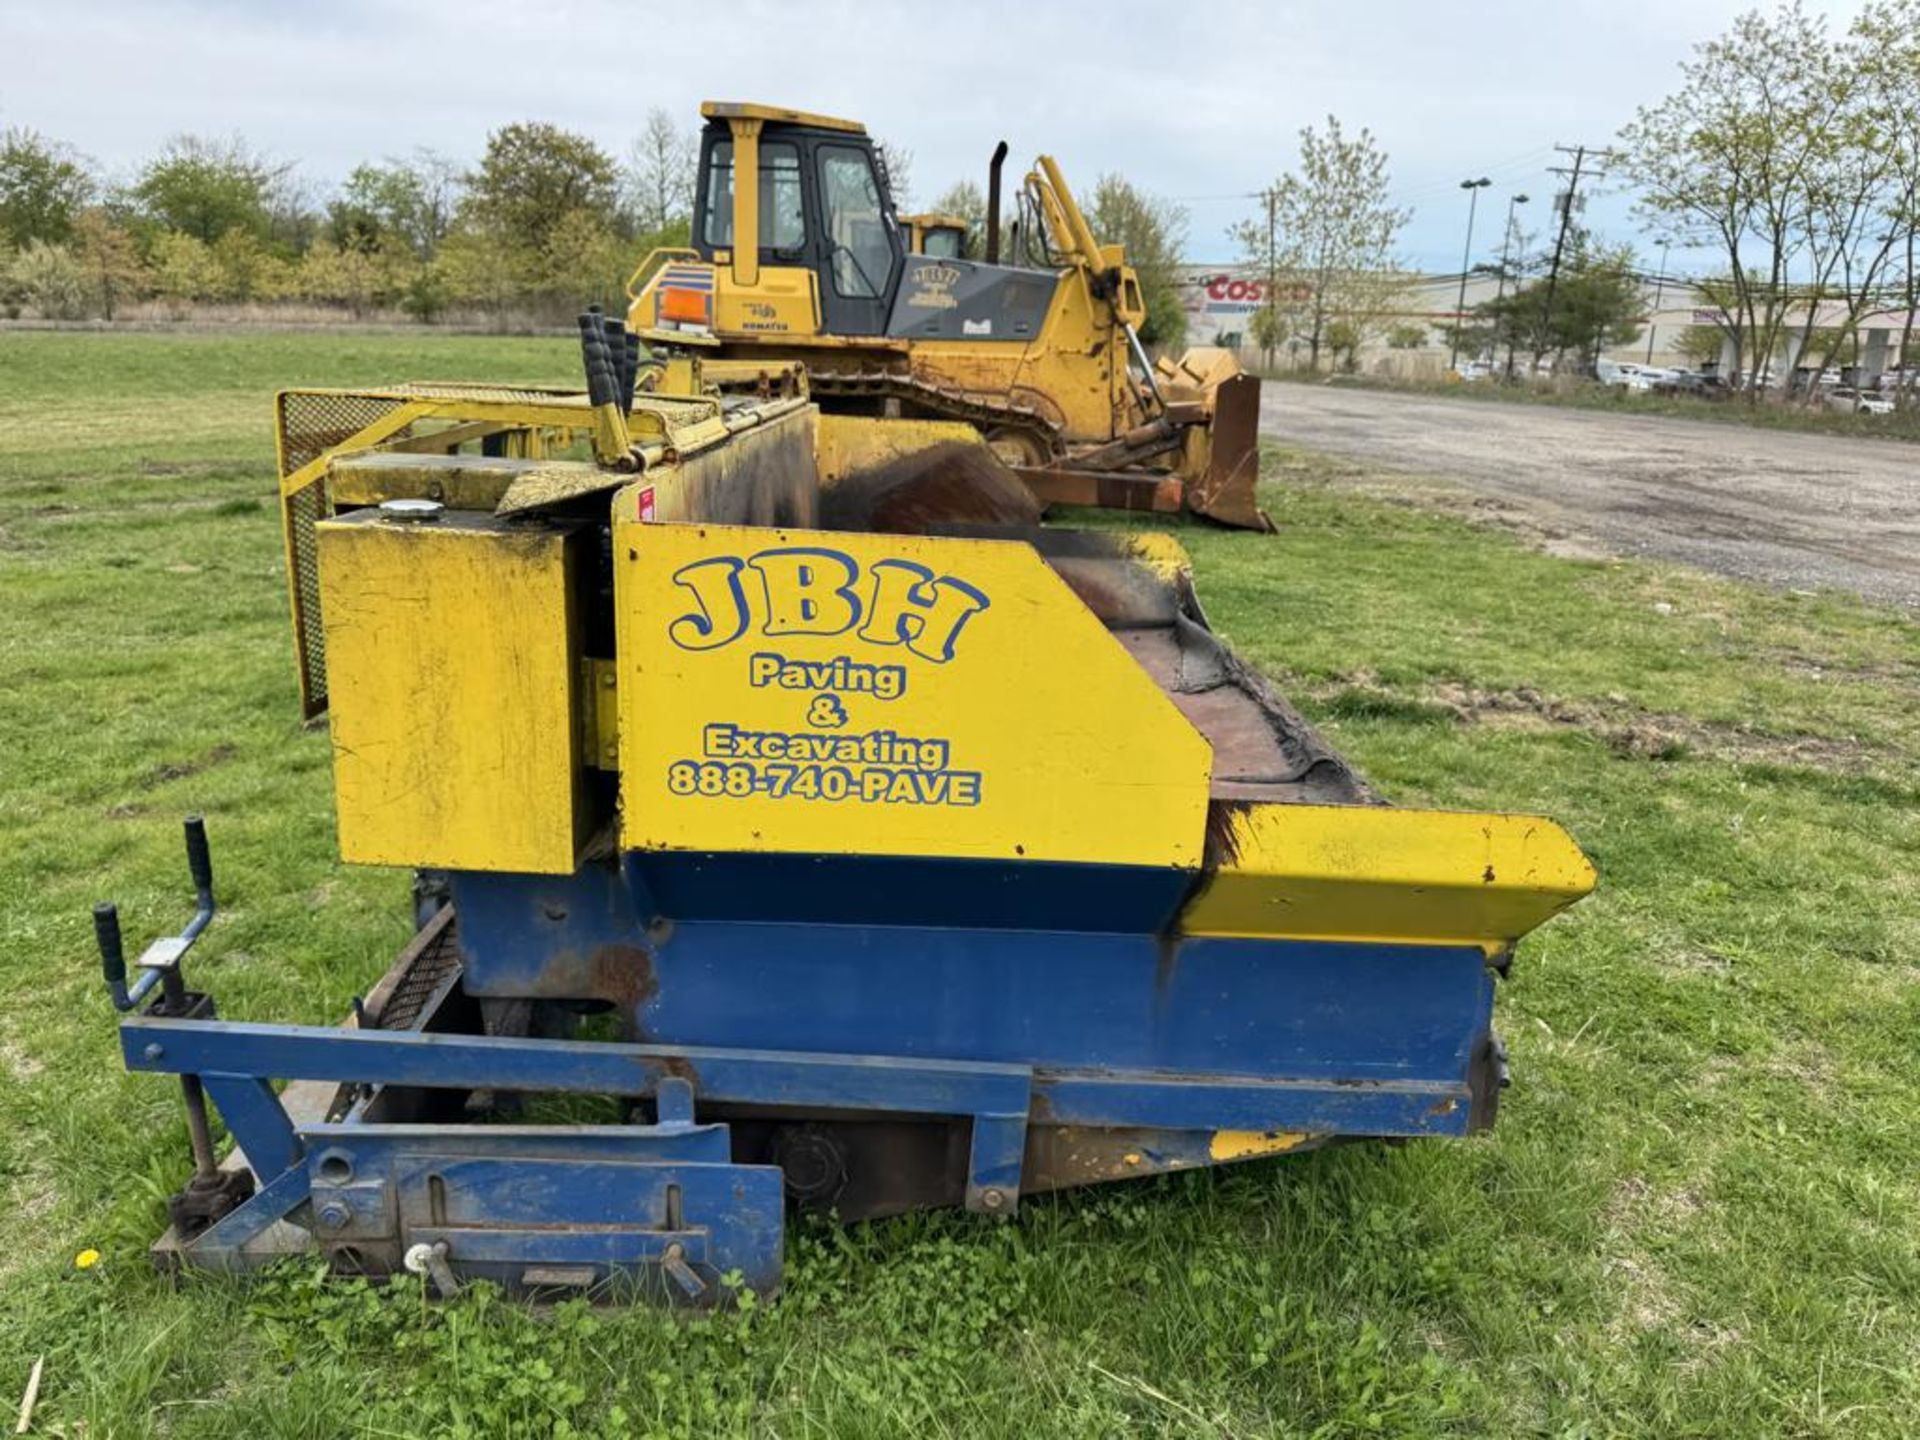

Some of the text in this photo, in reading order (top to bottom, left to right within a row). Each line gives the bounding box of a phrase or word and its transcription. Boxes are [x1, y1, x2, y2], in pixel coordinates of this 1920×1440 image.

[669, 547, 990, 663] JBH
[750, 653, 906, 700] Paving
[807, 694, 848, 728] &
[704, 723, 949, 771] Excavating
[668, 760, 981, 807] 888-740-PAVE
